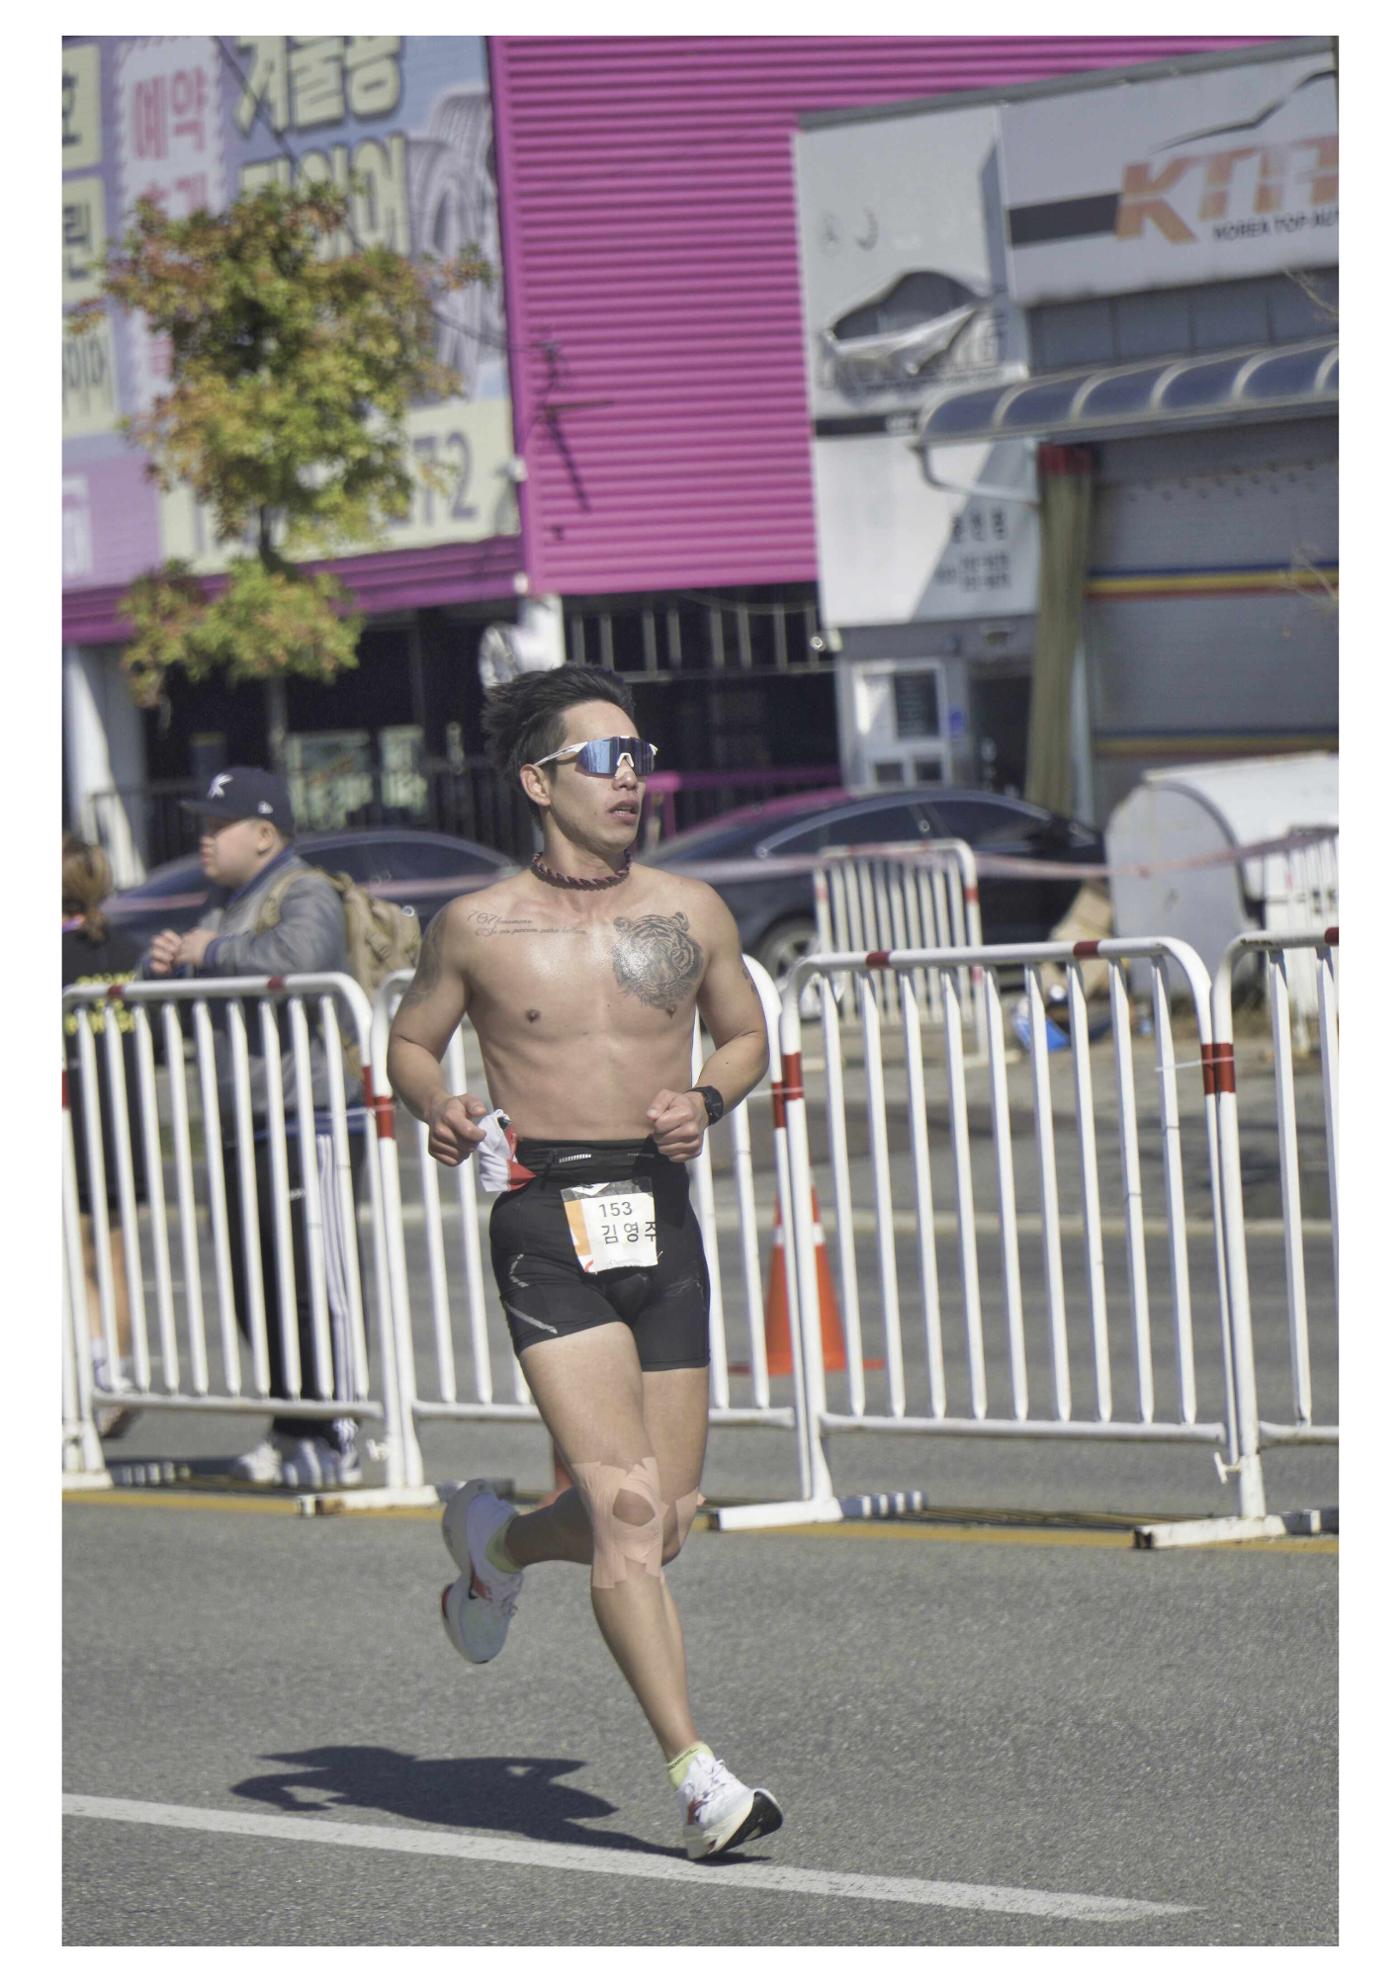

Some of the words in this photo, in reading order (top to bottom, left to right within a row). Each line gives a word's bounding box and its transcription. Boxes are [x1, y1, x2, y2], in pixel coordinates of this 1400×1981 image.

[132, 65, 208, 160] 예약
[599, 1201, 633, 1218] 153
[601, 1221, 657, 1245] 김영주
